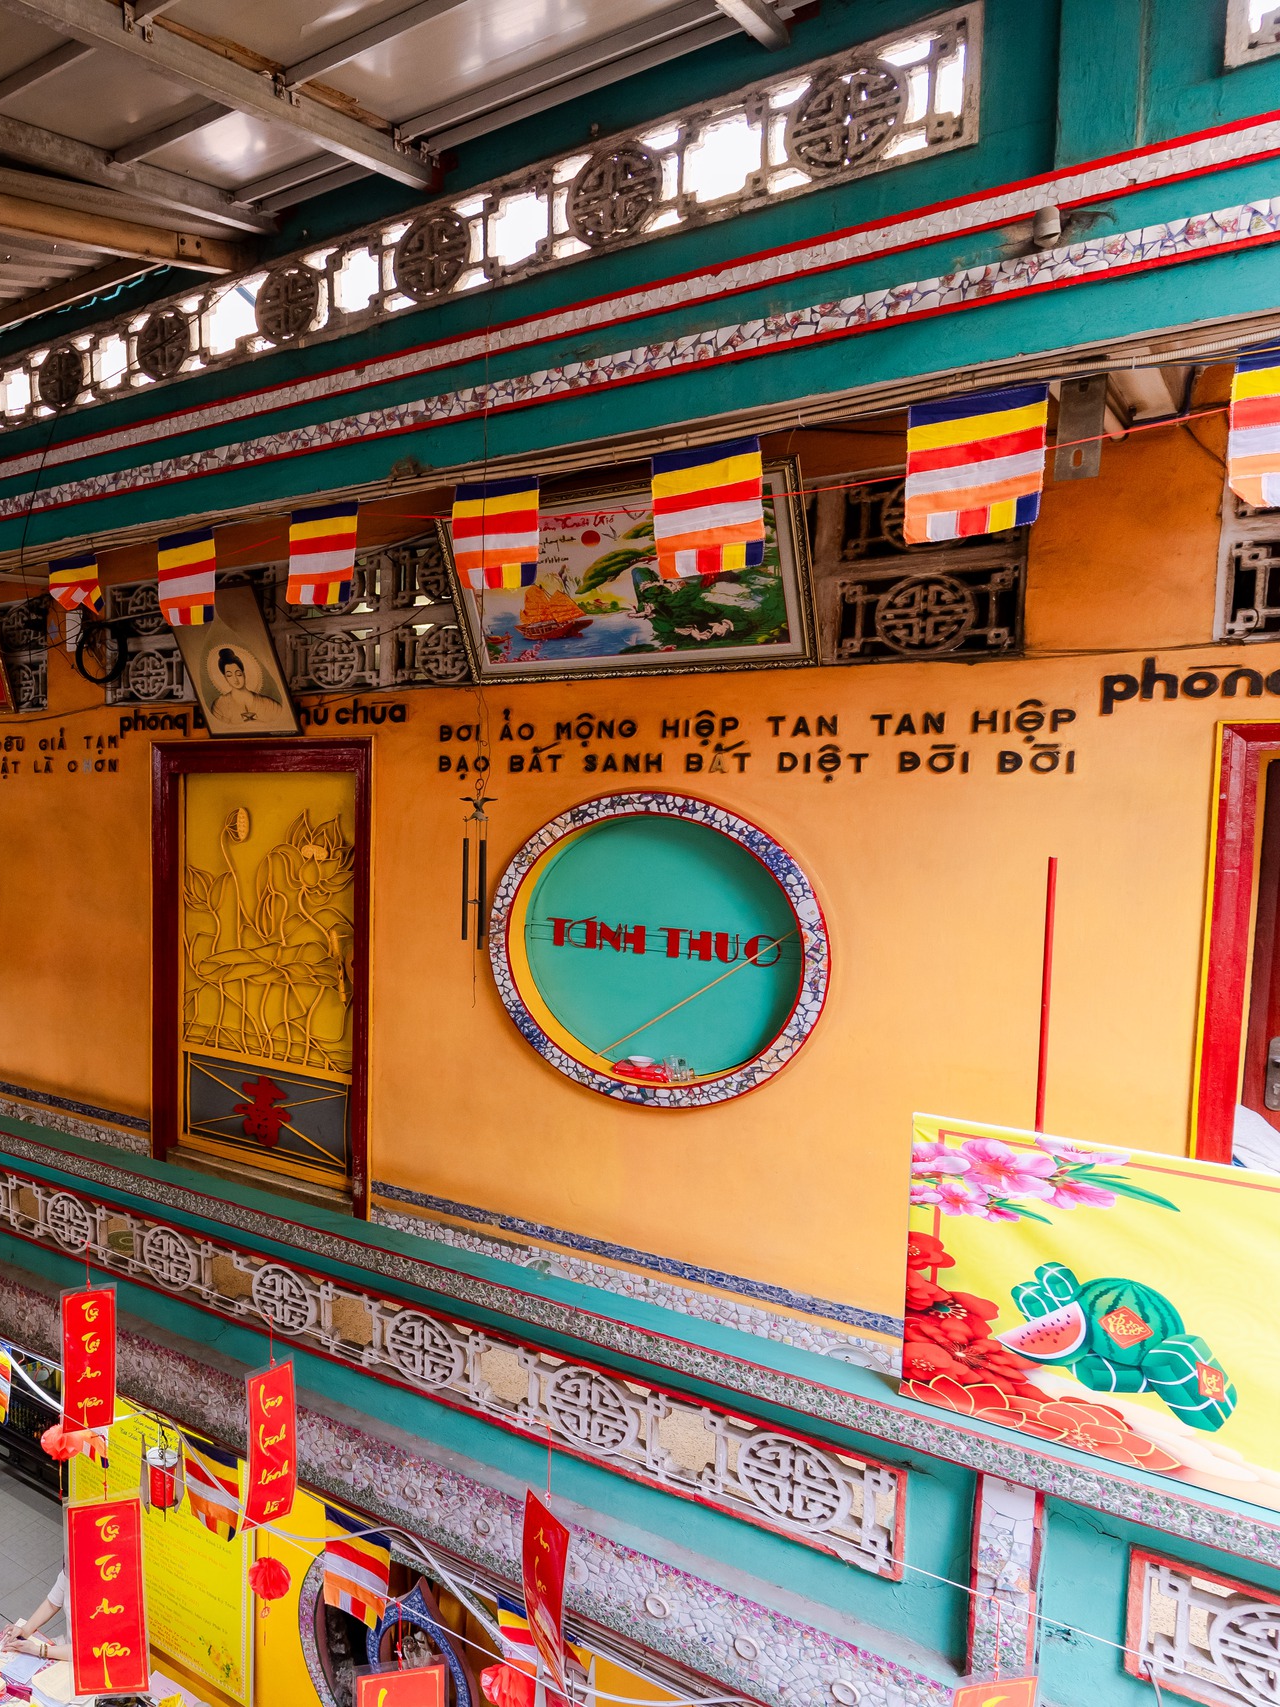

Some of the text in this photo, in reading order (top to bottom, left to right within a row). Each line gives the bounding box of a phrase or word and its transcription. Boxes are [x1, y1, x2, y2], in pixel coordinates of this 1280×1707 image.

[555, 713, 638, 748] MỘNG
[662, 709, 739, 746] HIỆP
[767, 714, 839, 737] TAN
[870, 711, 946, 736] TAN
[972, 699, 1077, 743] HIỆP
[508, 741, 564, 774] BẤT
[583, 753, 663, 774] SANH
[777, 744, 870, 783] DIỆT
